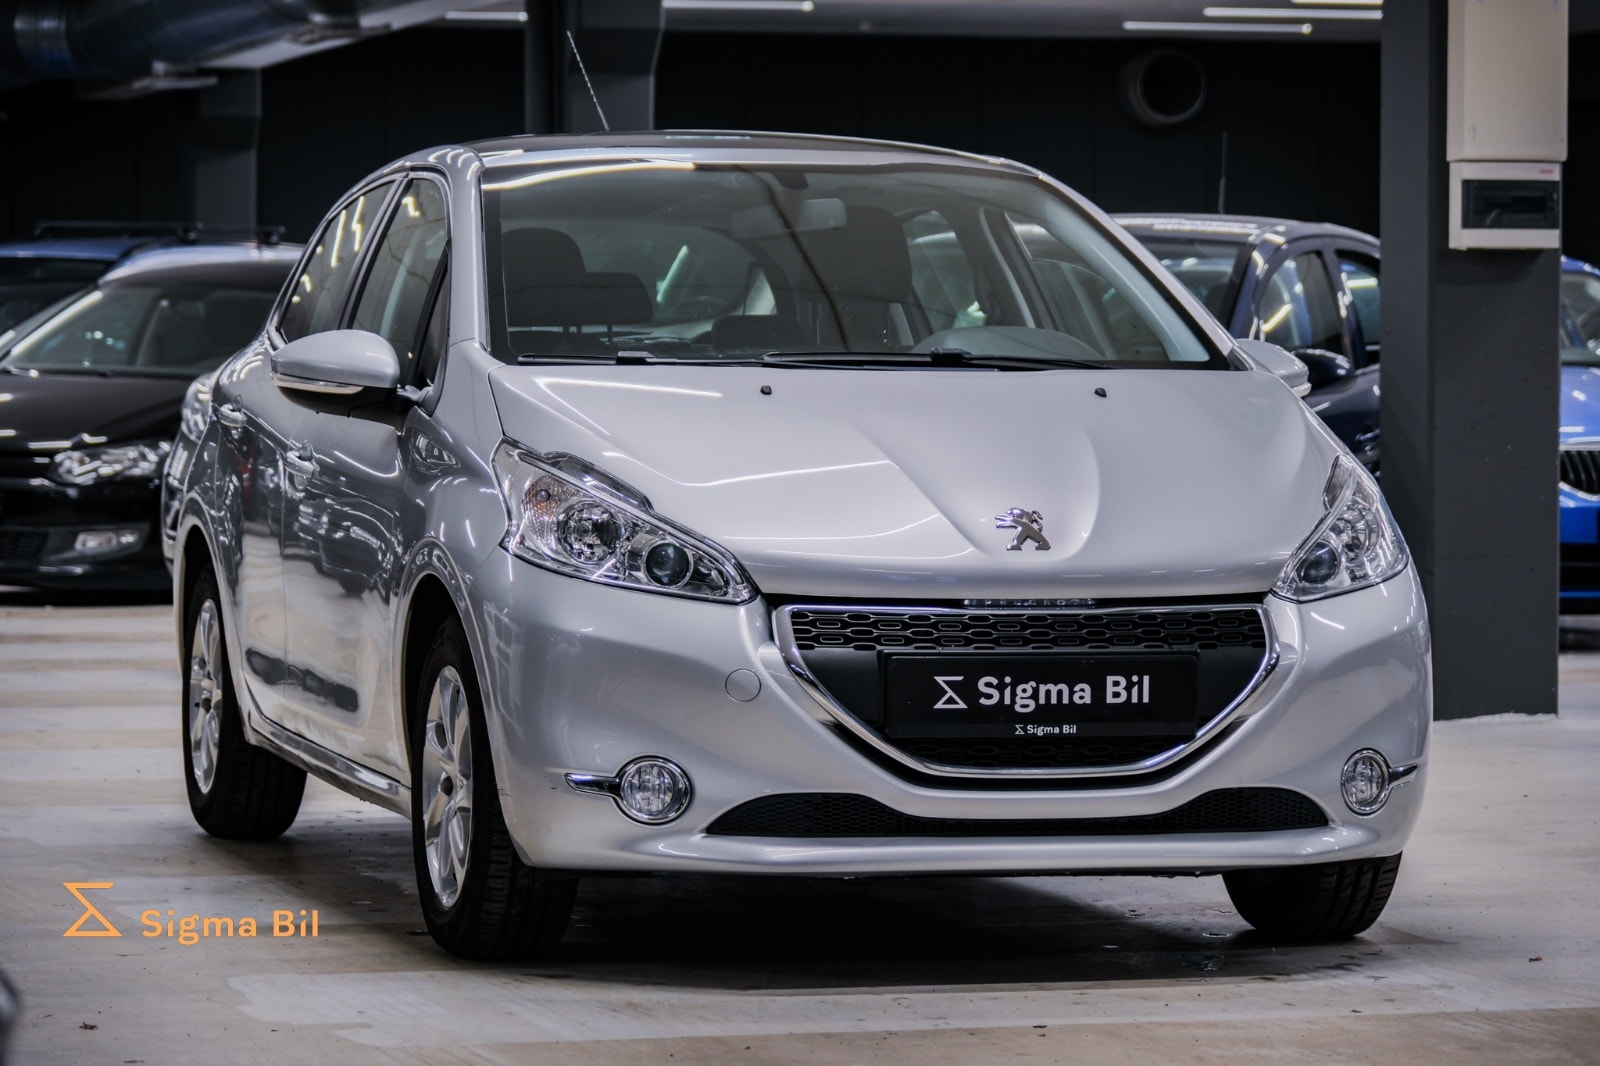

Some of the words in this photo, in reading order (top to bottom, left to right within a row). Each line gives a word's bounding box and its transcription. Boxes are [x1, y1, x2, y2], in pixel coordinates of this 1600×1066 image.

[978, 676, 1091, 712] Sigma
[1107, 675, 1150, 704] Bil
[1026, 724, 1060, 736] Sigma
[1062, 724, 1077, 734] Bil
